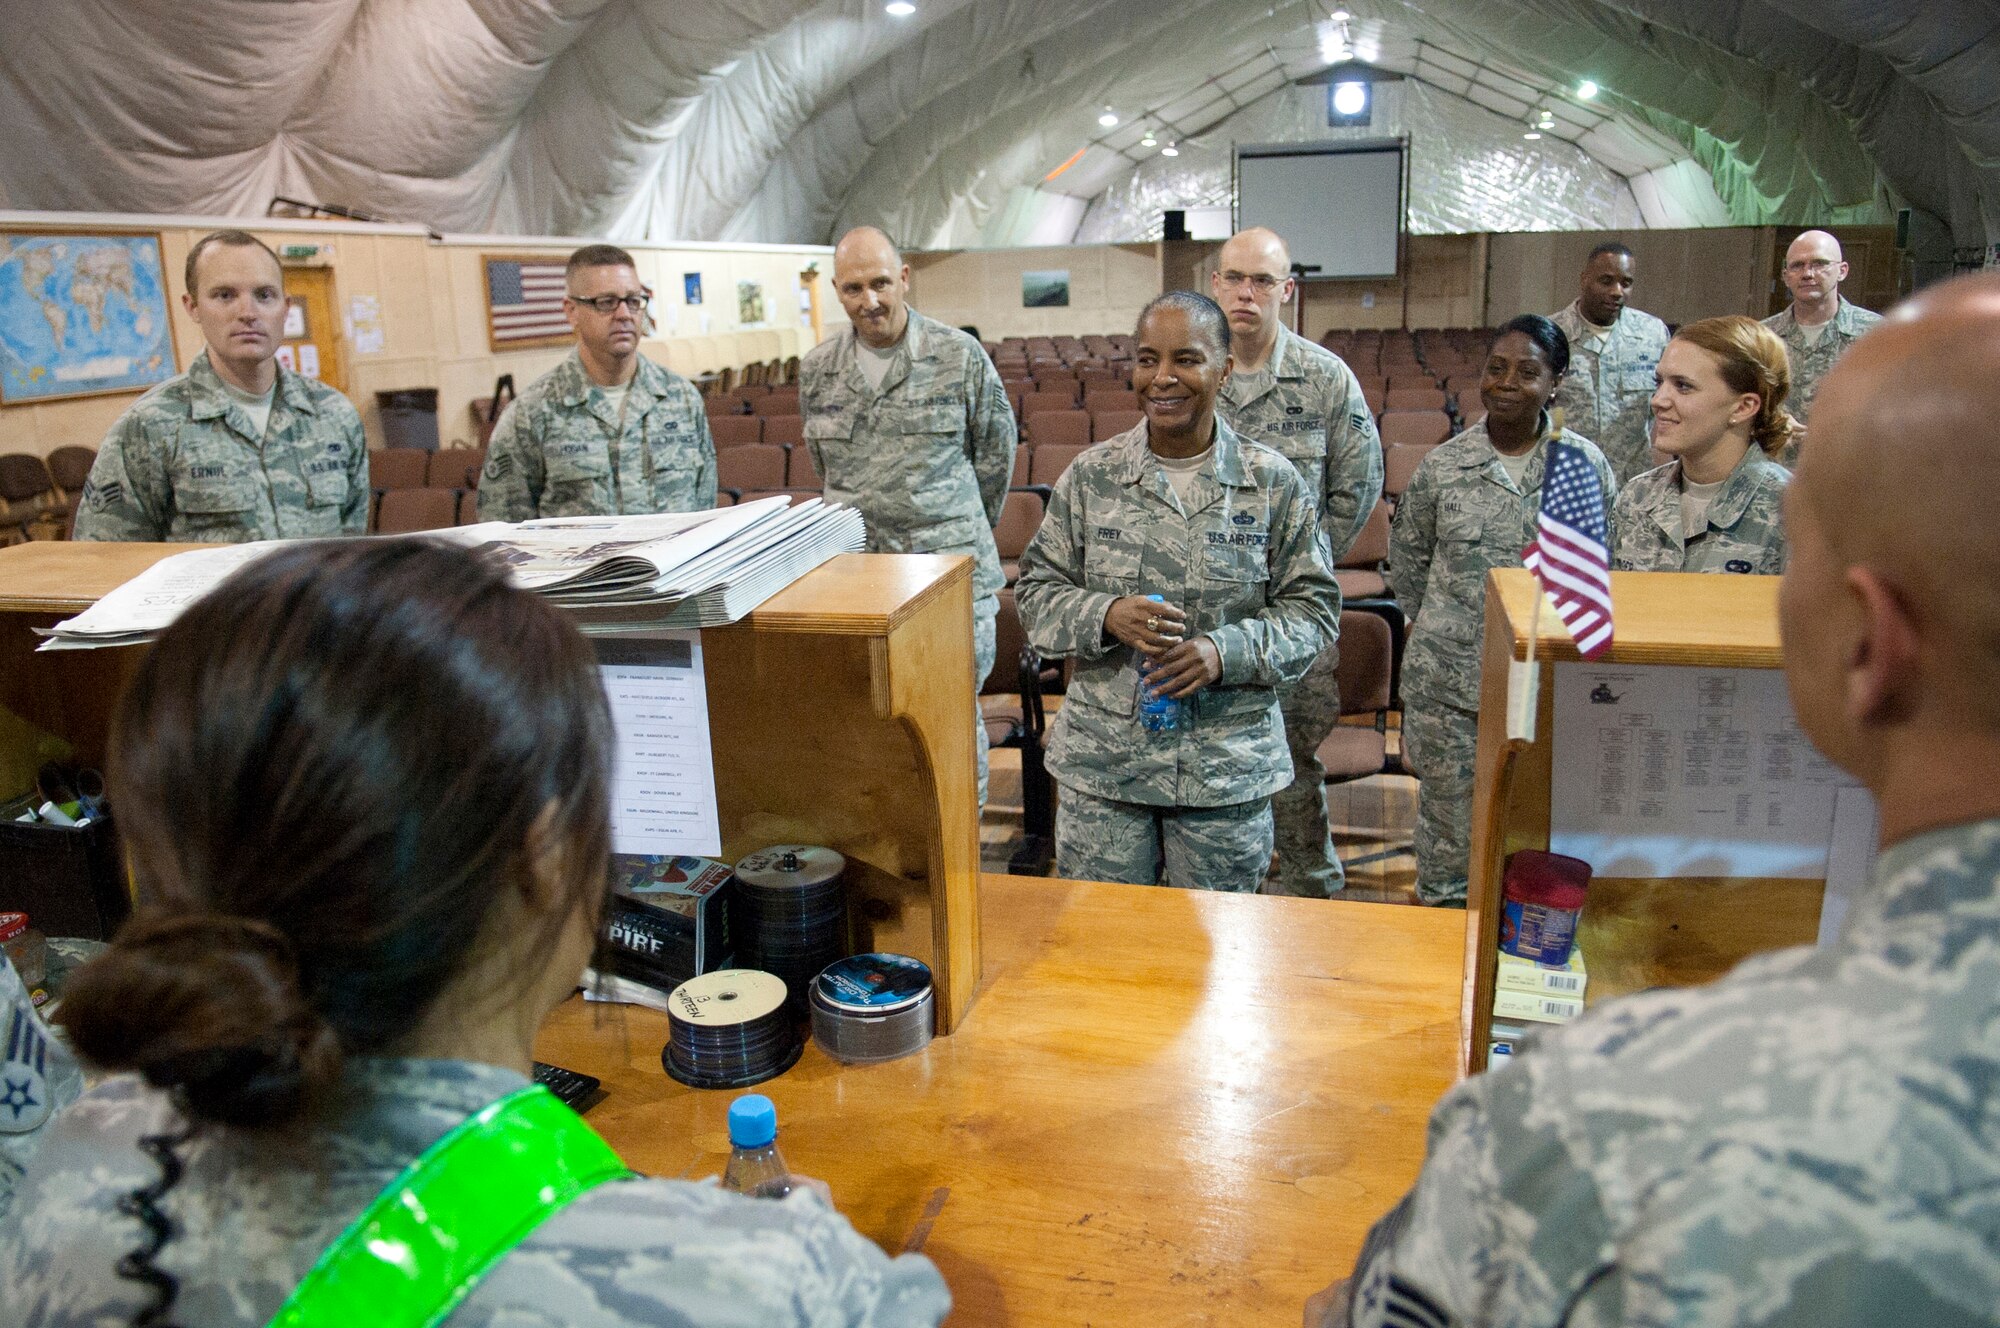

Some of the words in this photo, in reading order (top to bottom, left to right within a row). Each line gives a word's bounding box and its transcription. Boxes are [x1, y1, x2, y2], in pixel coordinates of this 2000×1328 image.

[1282, 421, 1294, 431] AIR
[1296, 420, 1320, 431] FORCE
[1097, 527, 1122, 541] FREY
[1208, 532, 1227, 544] U.S.
[1228, 533, 1245, 545] AIR
[609, 925, 664, 953] PIRE
[821, 973, 845, 988] AFTER
[675, 987, 705, 1018] THIRTEEN
